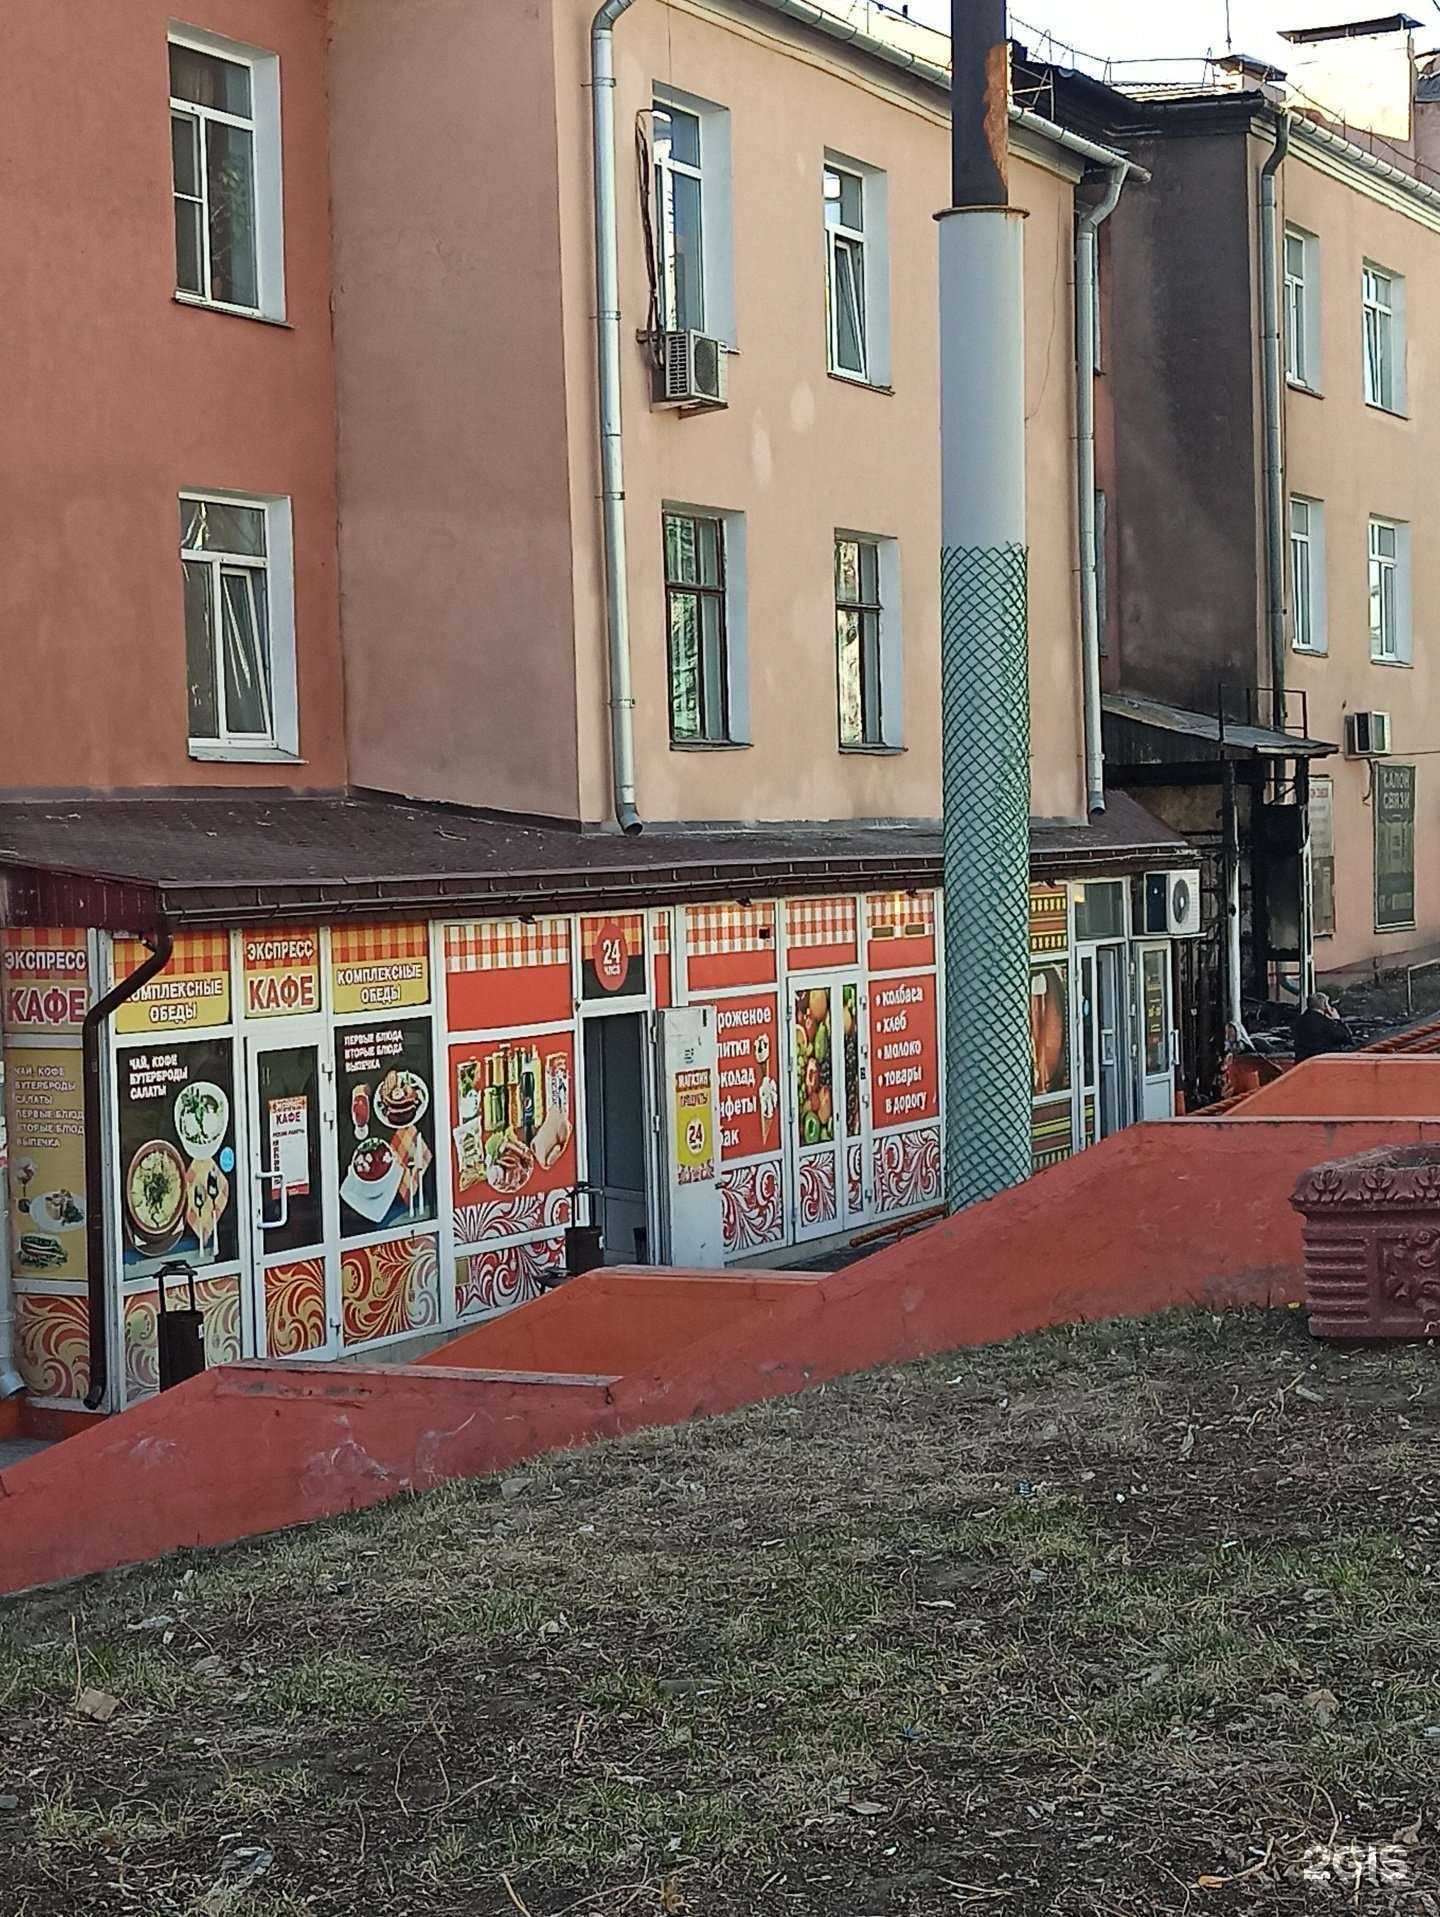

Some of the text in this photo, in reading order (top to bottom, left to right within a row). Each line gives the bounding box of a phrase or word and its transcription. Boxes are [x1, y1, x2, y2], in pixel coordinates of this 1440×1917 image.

[4, 950, 88, 971] ЭКСПРЕСС
[246, 940, 314, 961] ЭКСПРЕСС
[602, 938, 621, 965] 24
[336, 962, 423, 986] КОМПЛЕКСНЫЕ
[126, 979, 224, 1002] ОМПЛЕКСНЫЕ
[248, 973, 315, 1013] КАФЕ
[360, 983, 401, 1005] ОБЕДЫ
[882, 984, 923, 1006] колбаса
[6, 986, 87, 1026] КАФЕ
[149, 1001, 197, 1024] ОБЕДЫ
[717, 1006, 772, 1035] роженое
[882, 1010, 907, 1033] хлеб
[343, 1030, 404, 1046] ПЕРВЫЕ БЛЮДА
[151, 1053, 178, 1069] КОФЕ
[344, 1042, 403, 1060] ВТОРЫЕ БЛЮДА
[38, 1066, 65, 1077] КОФЕ
[129, 1066, 188, 1086] БУТЕРБРОДЫ
[345, 1058, 381, 1073] ВЫПЕЧКА
[15, 1081, 77, 1092] БУТЕРБРОДЫ
[719, 1067, 756, 1089] колад
[884, 1066, 922, 1087] товары
[130, 1084, 167, 1100] САЛАТЫ
[893, 1091, 927, 1115] дорогу
[55, 1110, 84, 1121] БЛЮД
[275, 1111, 302, 1126] КАФЕ
[56, 1124, 84, 1136] БЛЮД
[689, 1123, 703, 1144] 24
